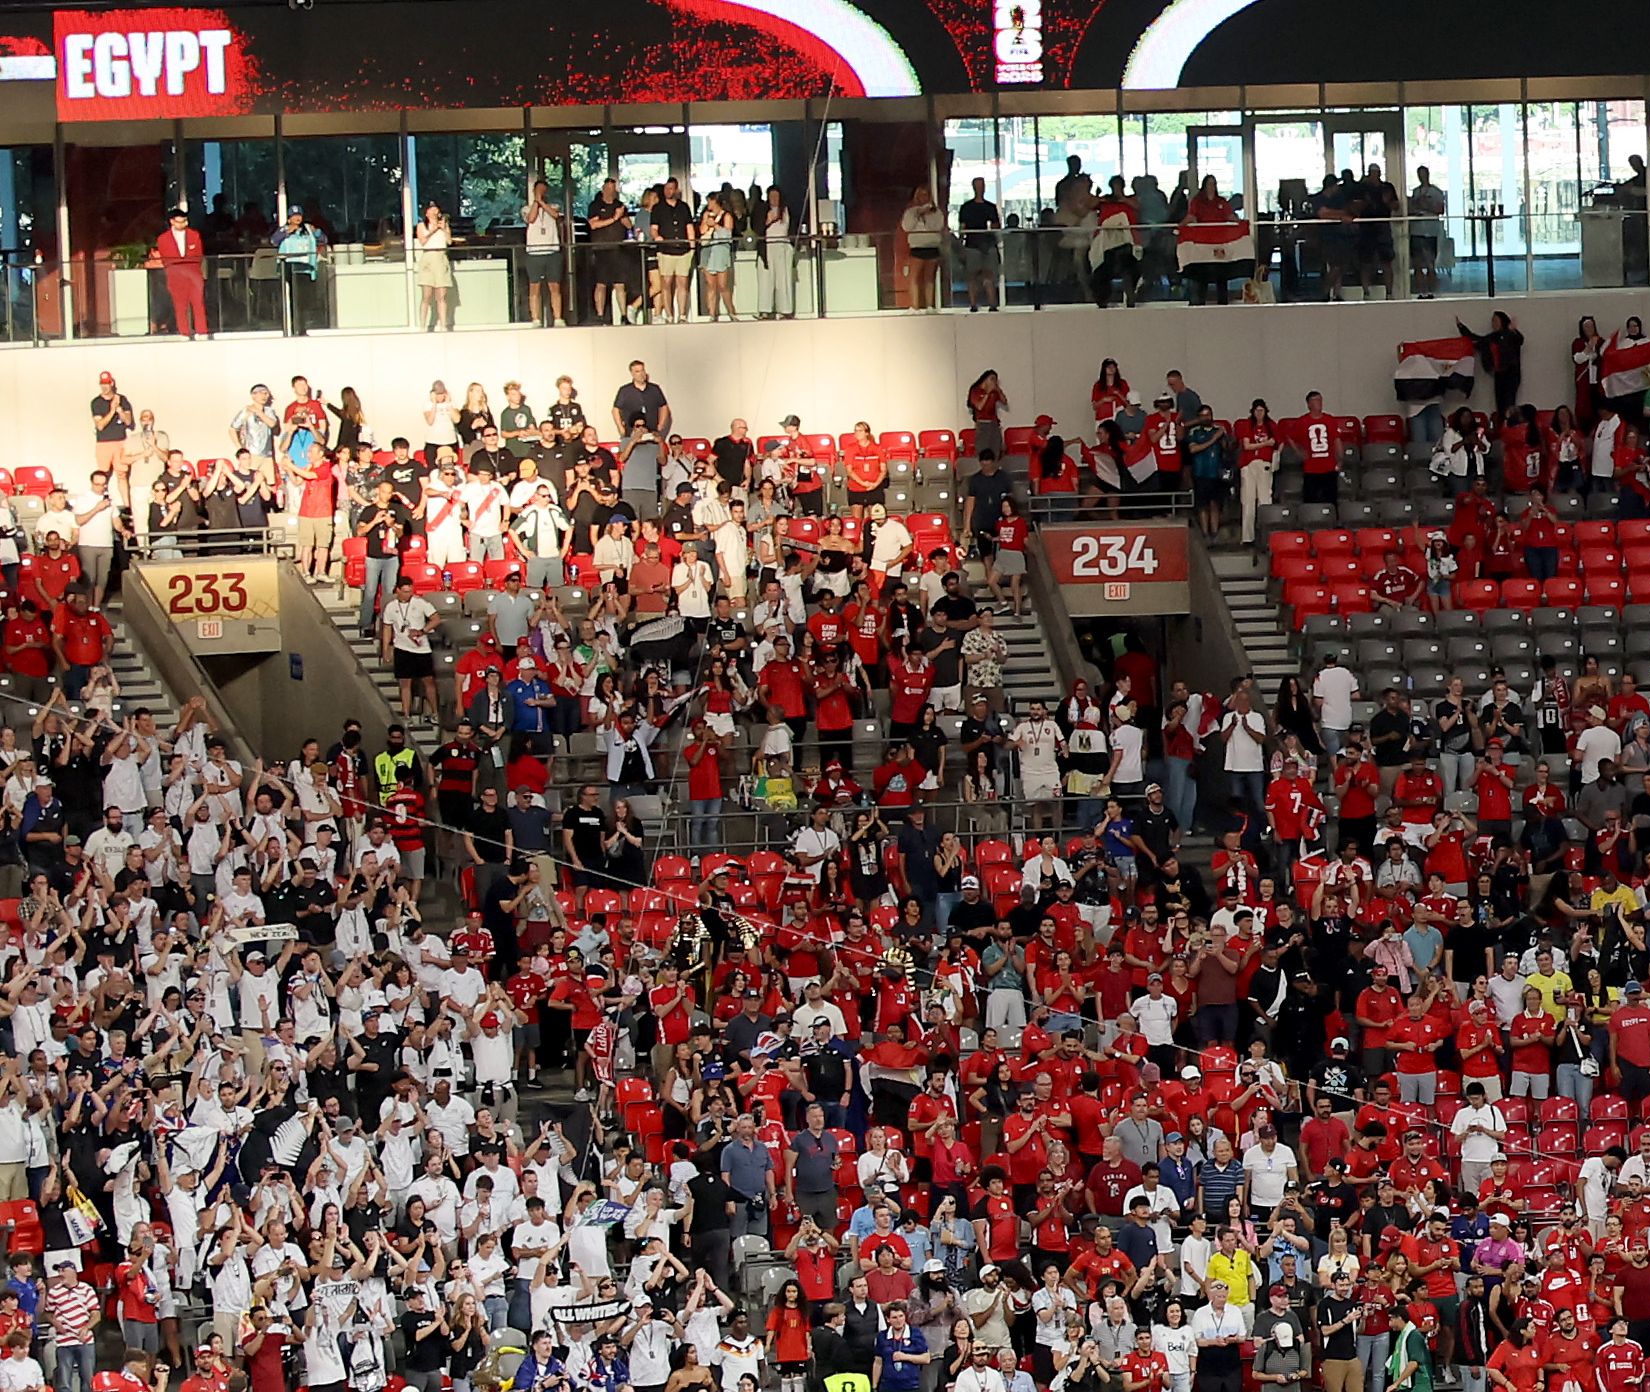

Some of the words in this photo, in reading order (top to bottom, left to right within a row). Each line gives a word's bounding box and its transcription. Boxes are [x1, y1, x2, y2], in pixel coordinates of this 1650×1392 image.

[66, 30, 232, 99] EGYPT
[1072, 534, 1159, 577] 234
[169, 571, 249, 614] 233
[1107, 583, 1127, 599] EXIT
[201, 621, 220, 639] EXIT
[395, 802, 408, 824] 9
[1289, 792, 1304, 815] 7
[249, 932, 270, 942] NEW
[71, 1219, 87, 1241] VISA
[553, 1306, 576, 1322] ALL
[1167, 1341, 1186, 1352] Bell
